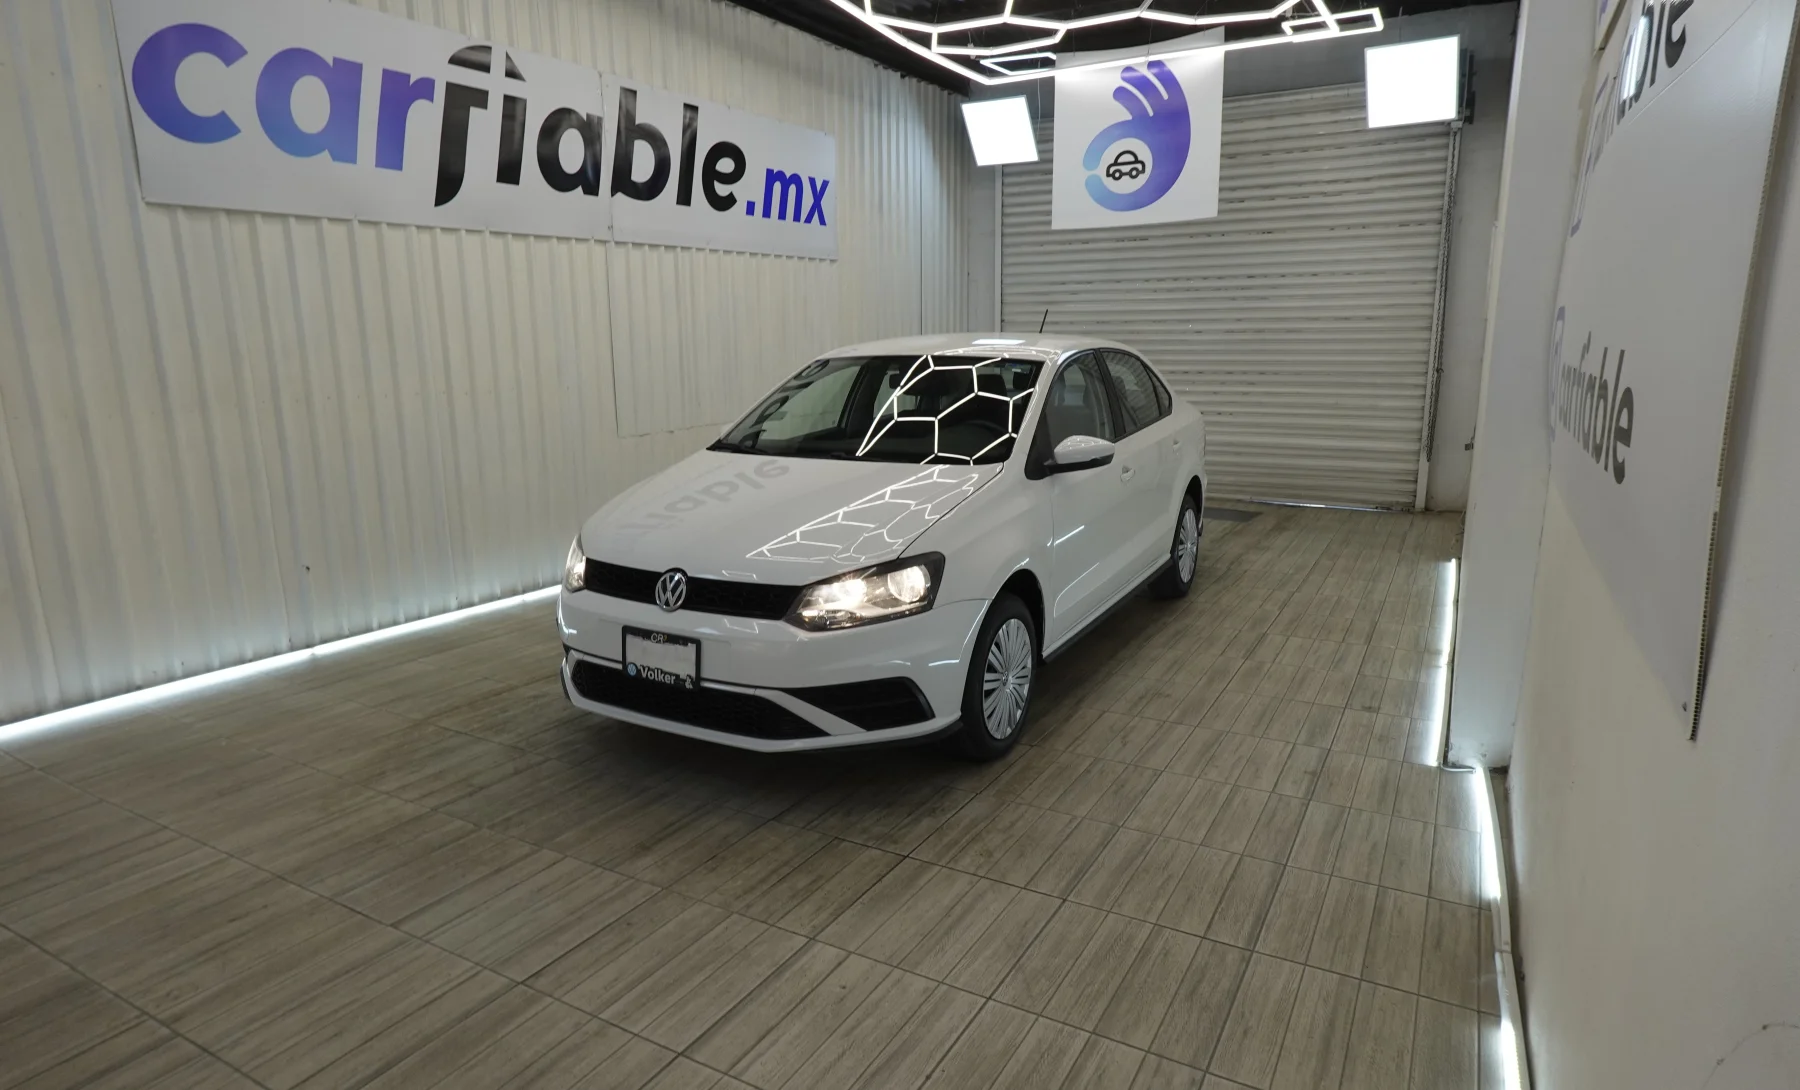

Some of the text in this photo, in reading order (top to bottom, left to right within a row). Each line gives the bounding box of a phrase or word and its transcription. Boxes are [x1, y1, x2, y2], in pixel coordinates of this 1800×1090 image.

[132, 22, 830, 227] carfiable.mx
[1558, 330, 1635, 485] carfiable
[640, 665, 676, 685] Volker
